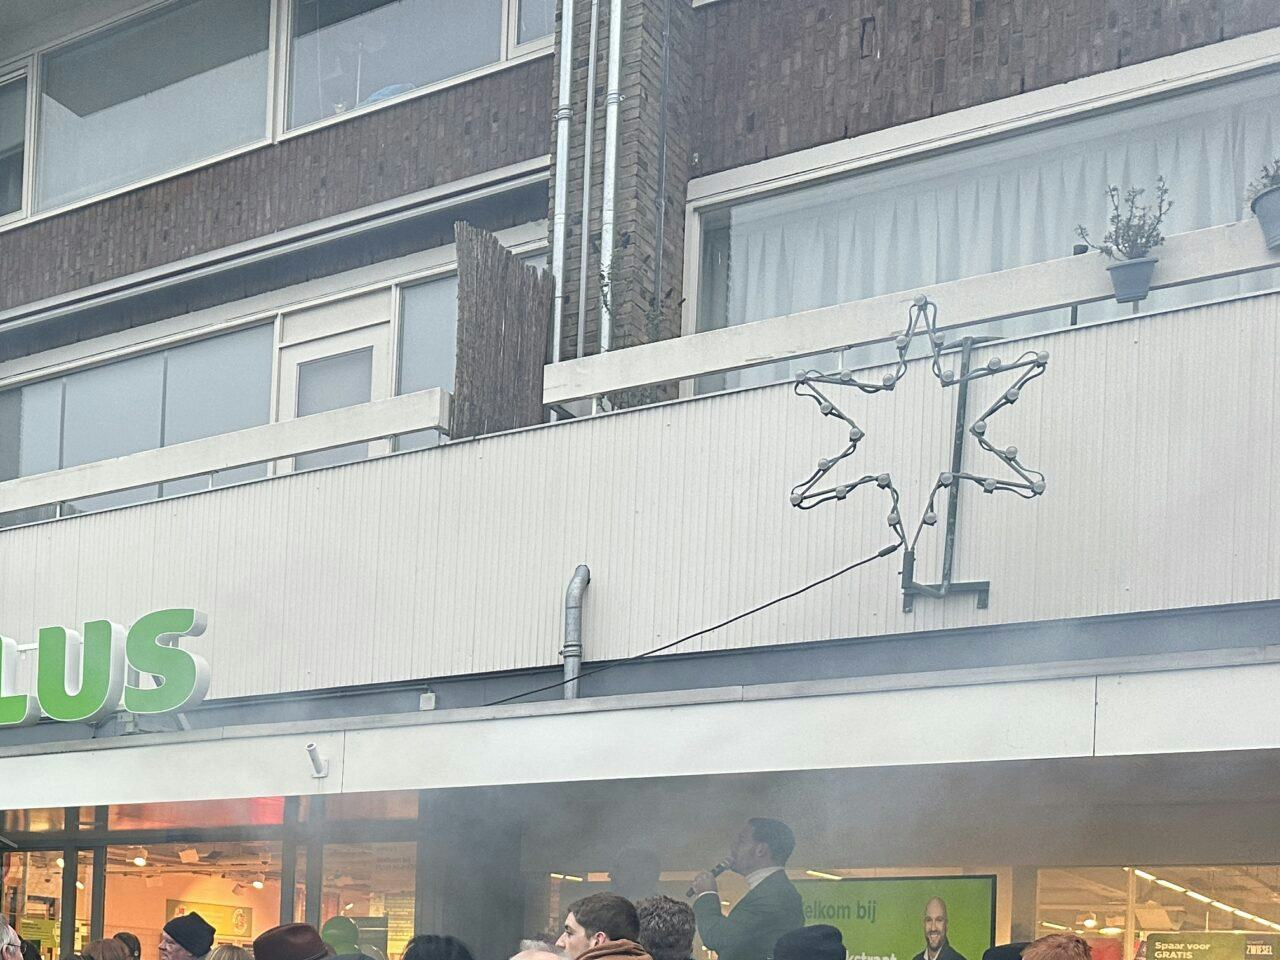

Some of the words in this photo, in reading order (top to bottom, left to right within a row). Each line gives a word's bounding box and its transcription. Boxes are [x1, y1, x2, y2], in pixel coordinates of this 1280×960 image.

[804, 900, 851, 919] elkom
[857, 899, 876, 923] bij
[1155, 941, 1185, 951] Spaar
[1187, 942, 1210, 950] voor
[1155, 951, 1193, 959] GRATIS
